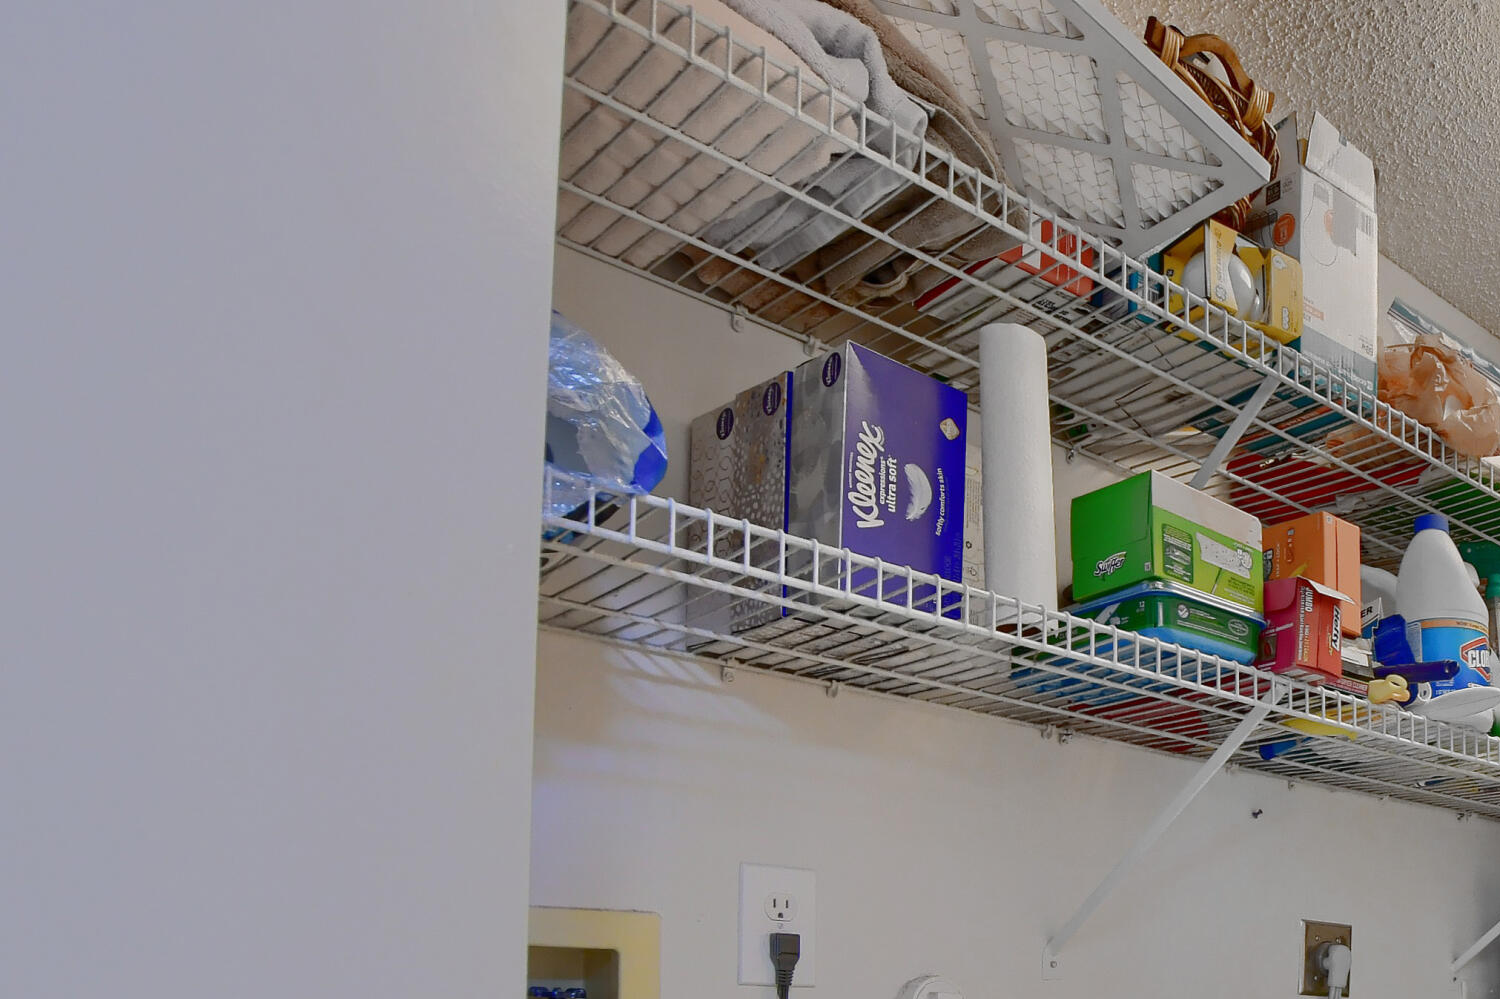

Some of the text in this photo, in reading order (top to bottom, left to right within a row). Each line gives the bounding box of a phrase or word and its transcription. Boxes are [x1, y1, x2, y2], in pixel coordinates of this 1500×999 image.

[848, 421, 885, 528] Kleenex
[885, 457, 897, 512] ultra soft
[935, 468, 946, 536] softly comforts skin
[1093, 553, 1125, 577] Swiffer
[1305, 587, 1313, 612] JUMBO
[1331, 607, 1340, 649] Hefty
[1467, 649, 1490, 668] CLO
